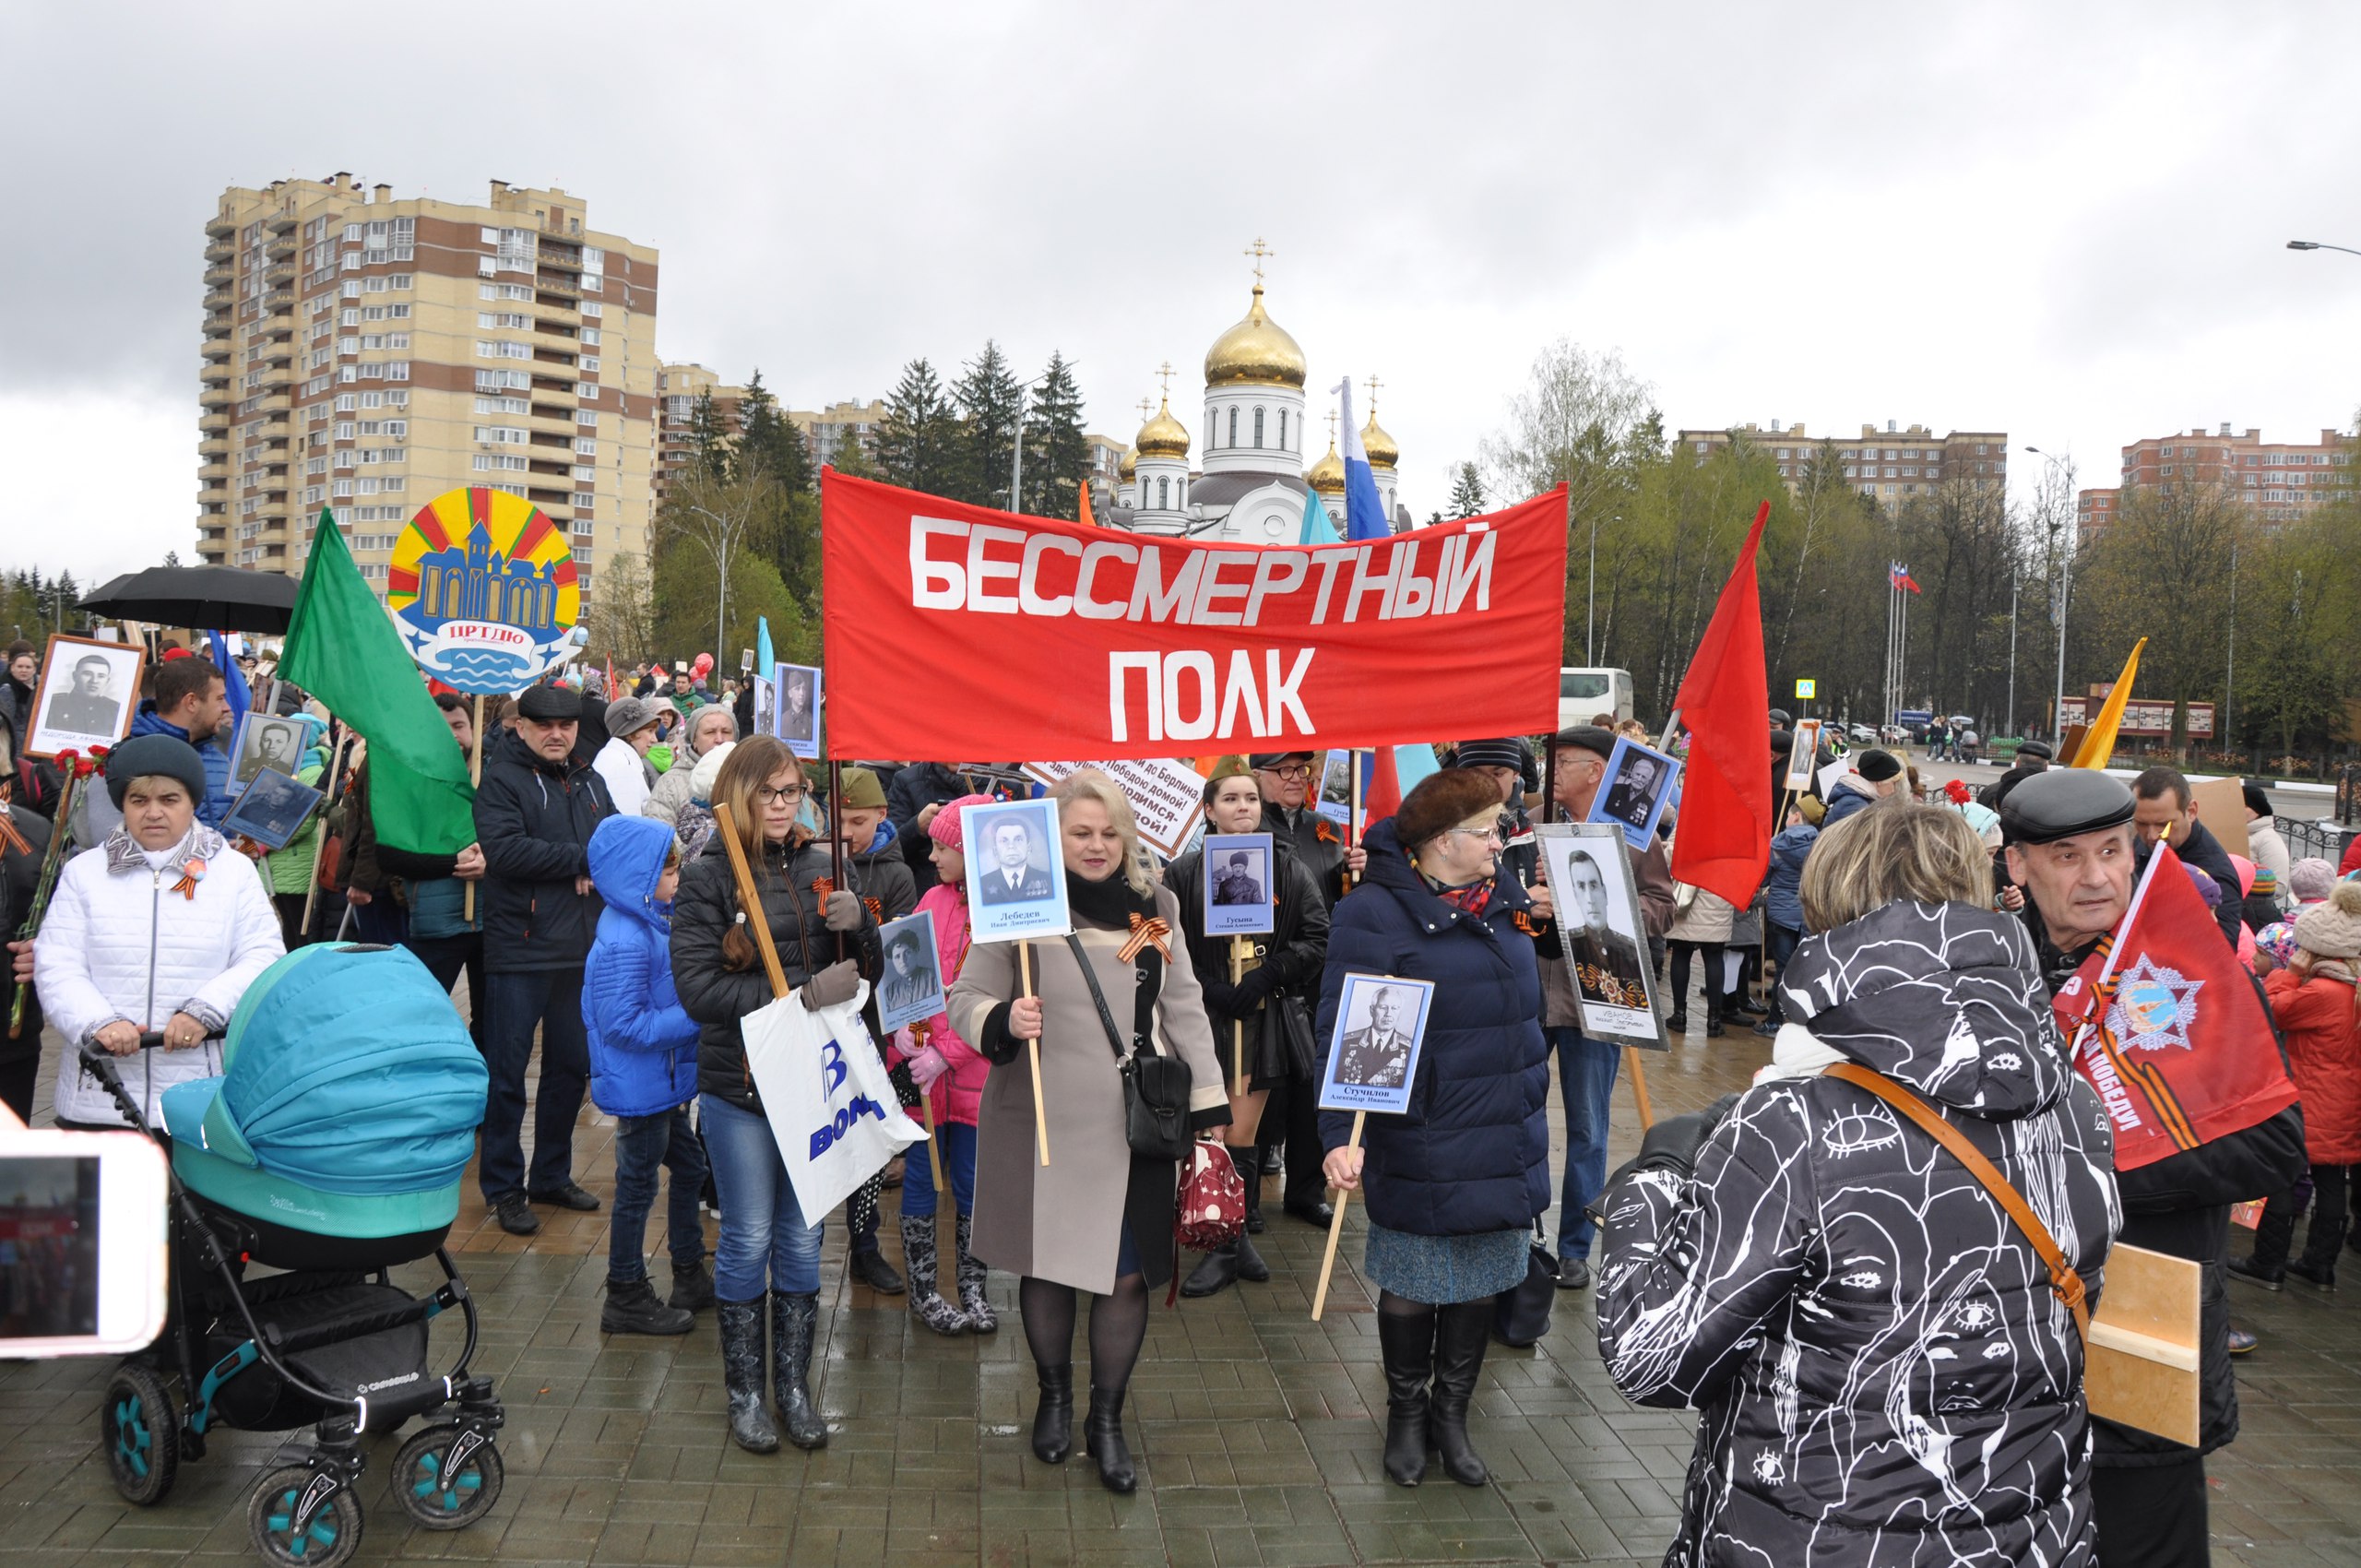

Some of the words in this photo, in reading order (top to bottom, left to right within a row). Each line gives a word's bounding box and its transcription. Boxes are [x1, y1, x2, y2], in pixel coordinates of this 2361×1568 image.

[909, 515, 1498, 627] БЕССМЕРТНЫЙ
[1108, 647, 1316, 742] ПОЛК
[1144, 763, 1158, 776] до
[1157, 766, 1199, 802] Берлина,
[1148, 784, 1188, 811] домой!
[1000, 910, 1040, 921] Лебедев
[1330, 1093, 1365, 1103] Александр
[1344, 1086, 1390, 1098] Стучилов
[2087, 1053, 2142, 1133] ПОБЕДУ!
